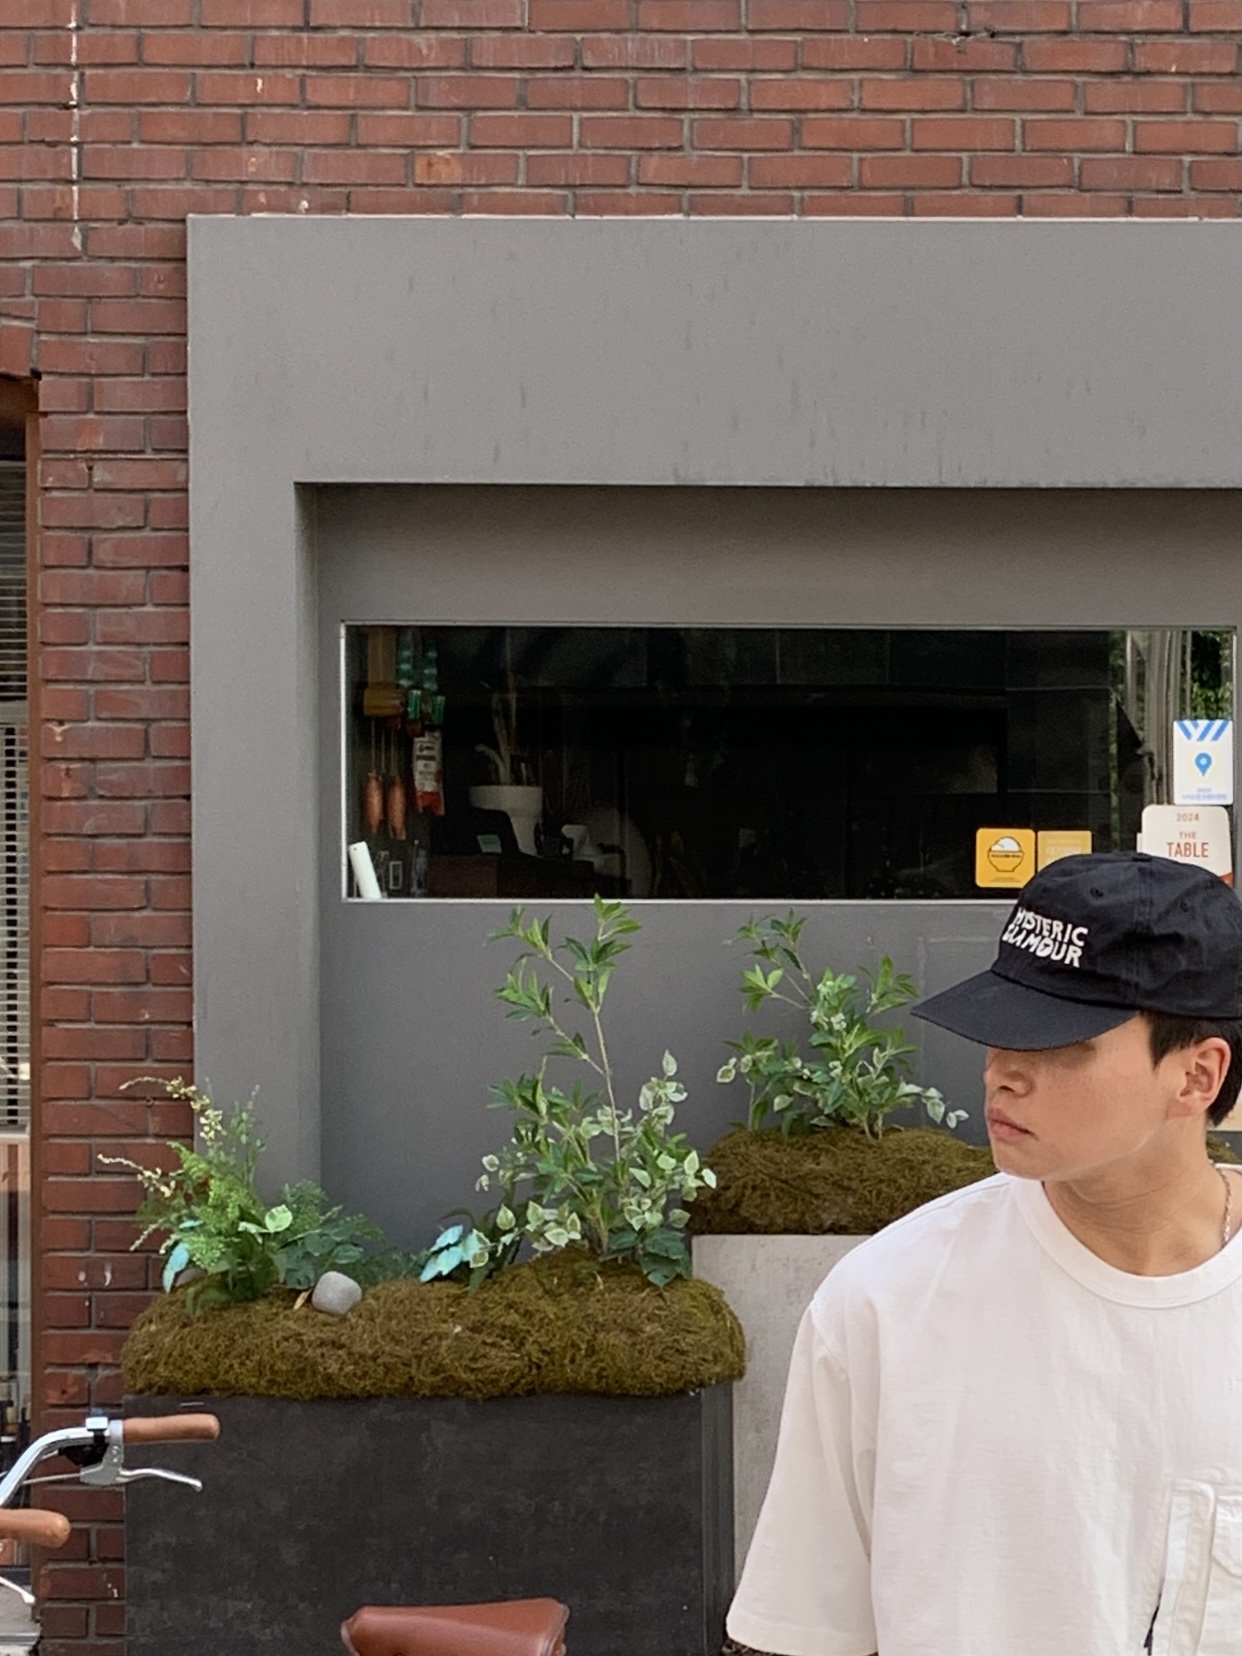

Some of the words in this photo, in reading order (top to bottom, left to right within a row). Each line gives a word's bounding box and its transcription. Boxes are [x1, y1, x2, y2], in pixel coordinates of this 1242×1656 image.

[1176, 812, 1199, 822] 2024
[1179, 831, 1196, 839] THE
[1167, 842, 1209, 858] TABLE
[1012, 907, 1088, 947] HYSTERIC
[1001, 923, 1083, 968] GLAMOUR
